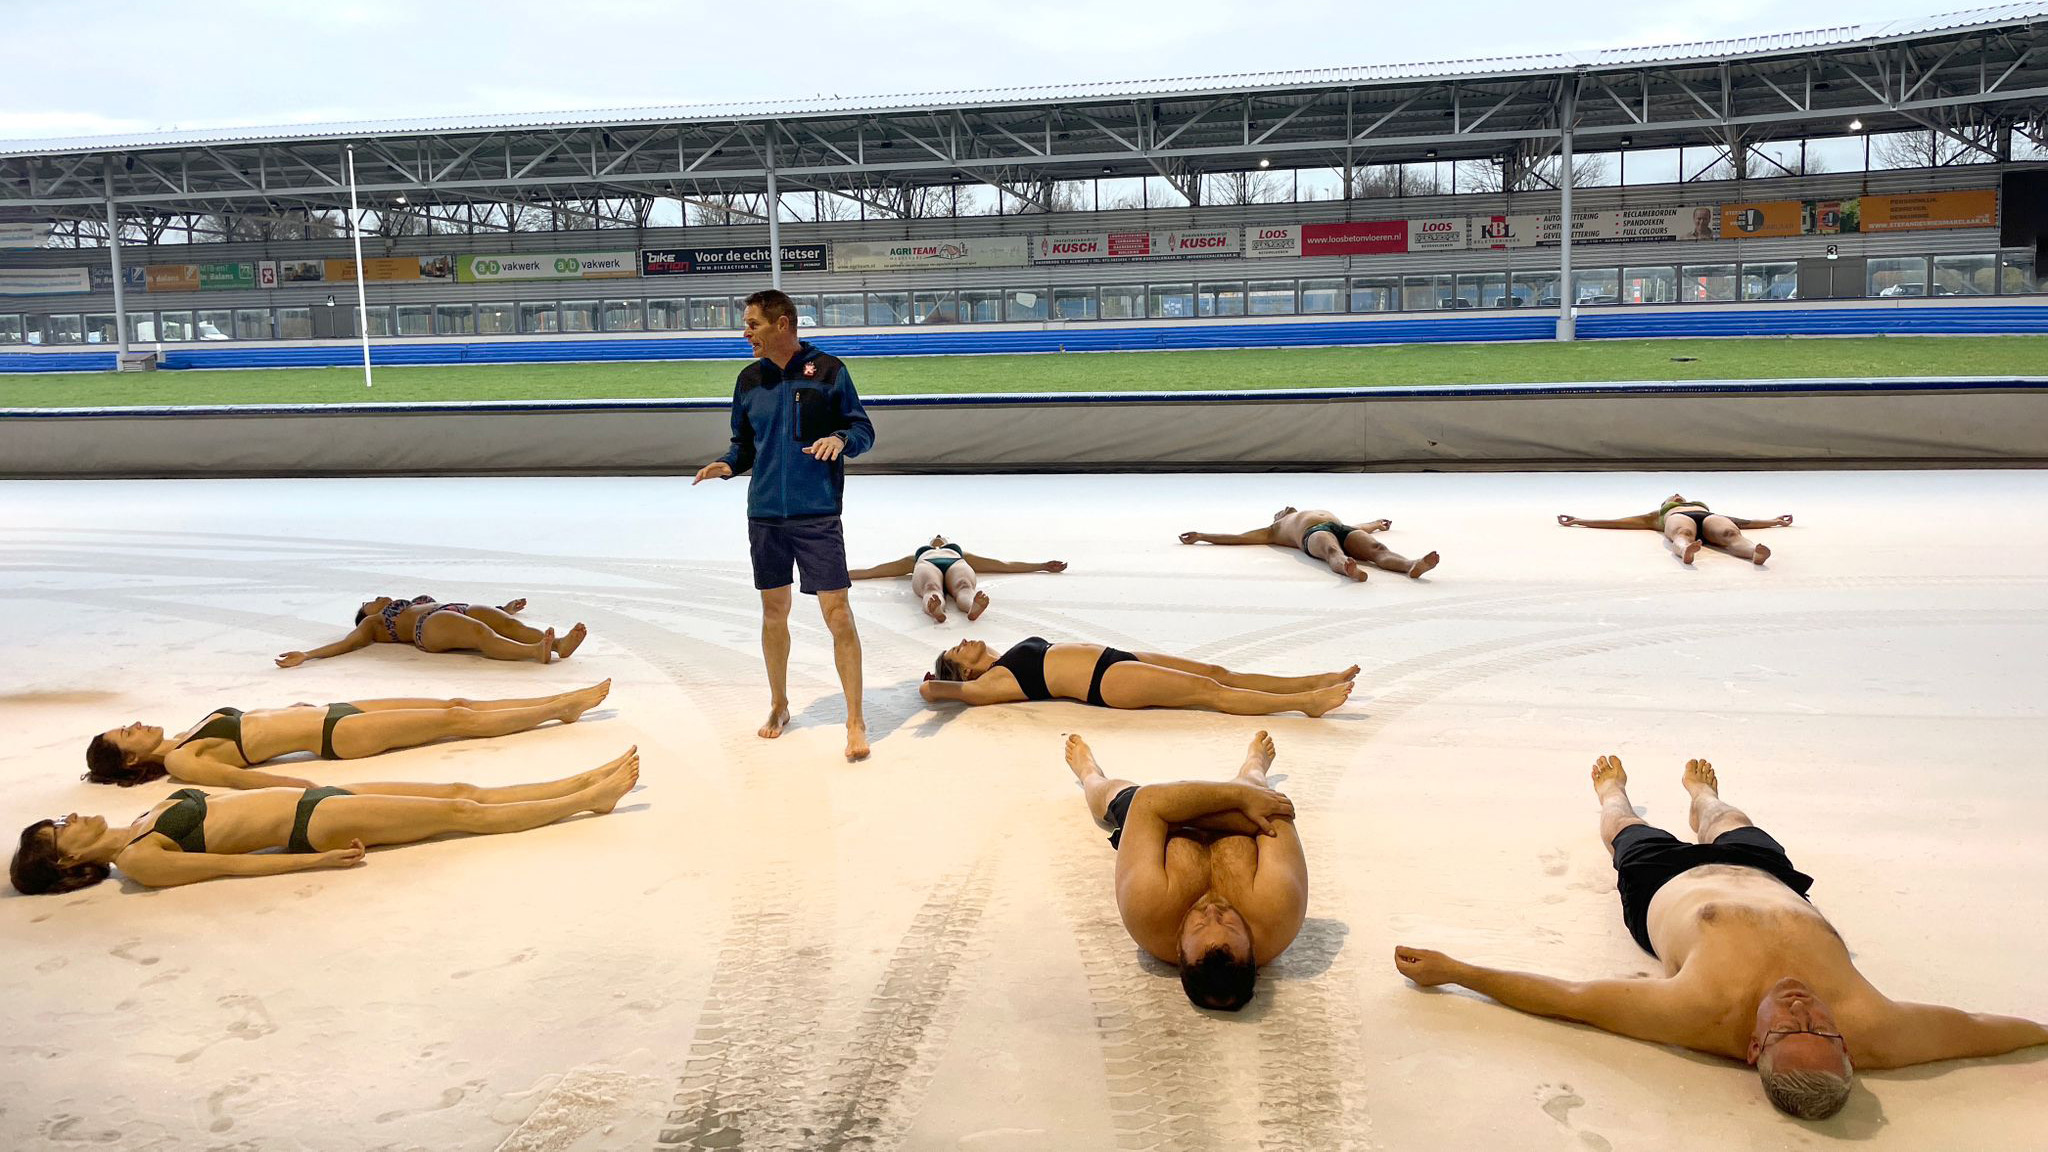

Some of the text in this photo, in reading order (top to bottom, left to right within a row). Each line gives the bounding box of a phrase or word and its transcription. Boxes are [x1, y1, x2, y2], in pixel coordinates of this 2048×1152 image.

[1544, 213, 1599, 222] AUTOTTERING
[1623, 209, 1677, 218] RECLAMEBORDEN
[1422, 222, 1453, 232] LOOS
[1543, 222, 1584, 230] LICHTKEN
[1623, 218, 1664, 226] SPANDOEKEN
[1259, 229, 1288, 239] LOOS
[1481, 221, 1516, 239] KBL
[1543, 230, 1600, 239] GEVELETTERING
[1623, 227, 1668, 236] FULL COLOURS
[1180, 236, 1226, 249] KUSCH
[1307, 232, 1402, 244] www.loosbetonvloeren.nl
[1052, 242, 1097, 254] KUSCH
[1827, 245, 1836, 255] 3
[695, 248, 820, 262] Voor de echt fietser
[502, 261, 541, 271] vakwerk
[582, 258, 621, 269] vakwerk
